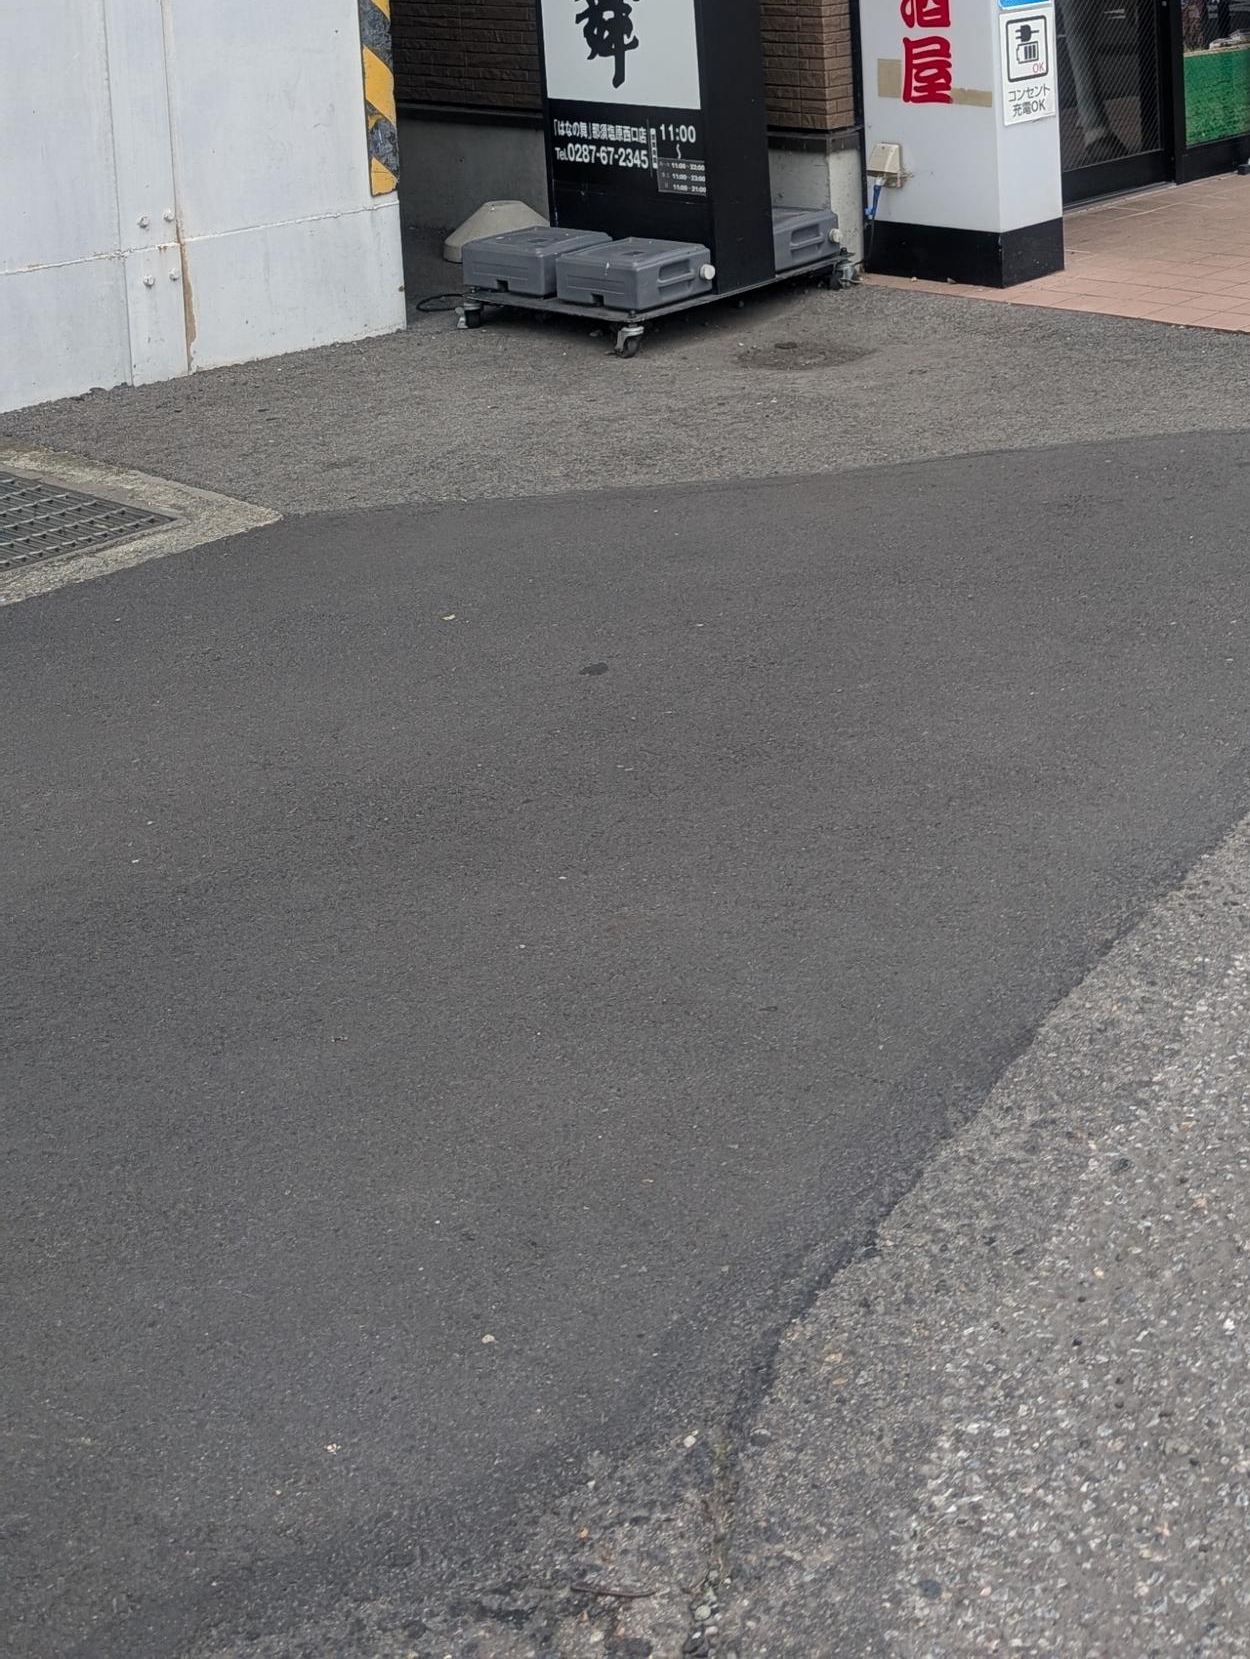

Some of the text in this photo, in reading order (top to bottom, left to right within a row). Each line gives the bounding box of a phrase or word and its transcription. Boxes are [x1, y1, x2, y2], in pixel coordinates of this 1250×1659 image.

[1032, 61, 1045, 73] OK
[1008, 83, 1051, 103] コンセント
[1012, 99, 1046, 118] 充電OK
[660, 123, 696, 143] 11:00
